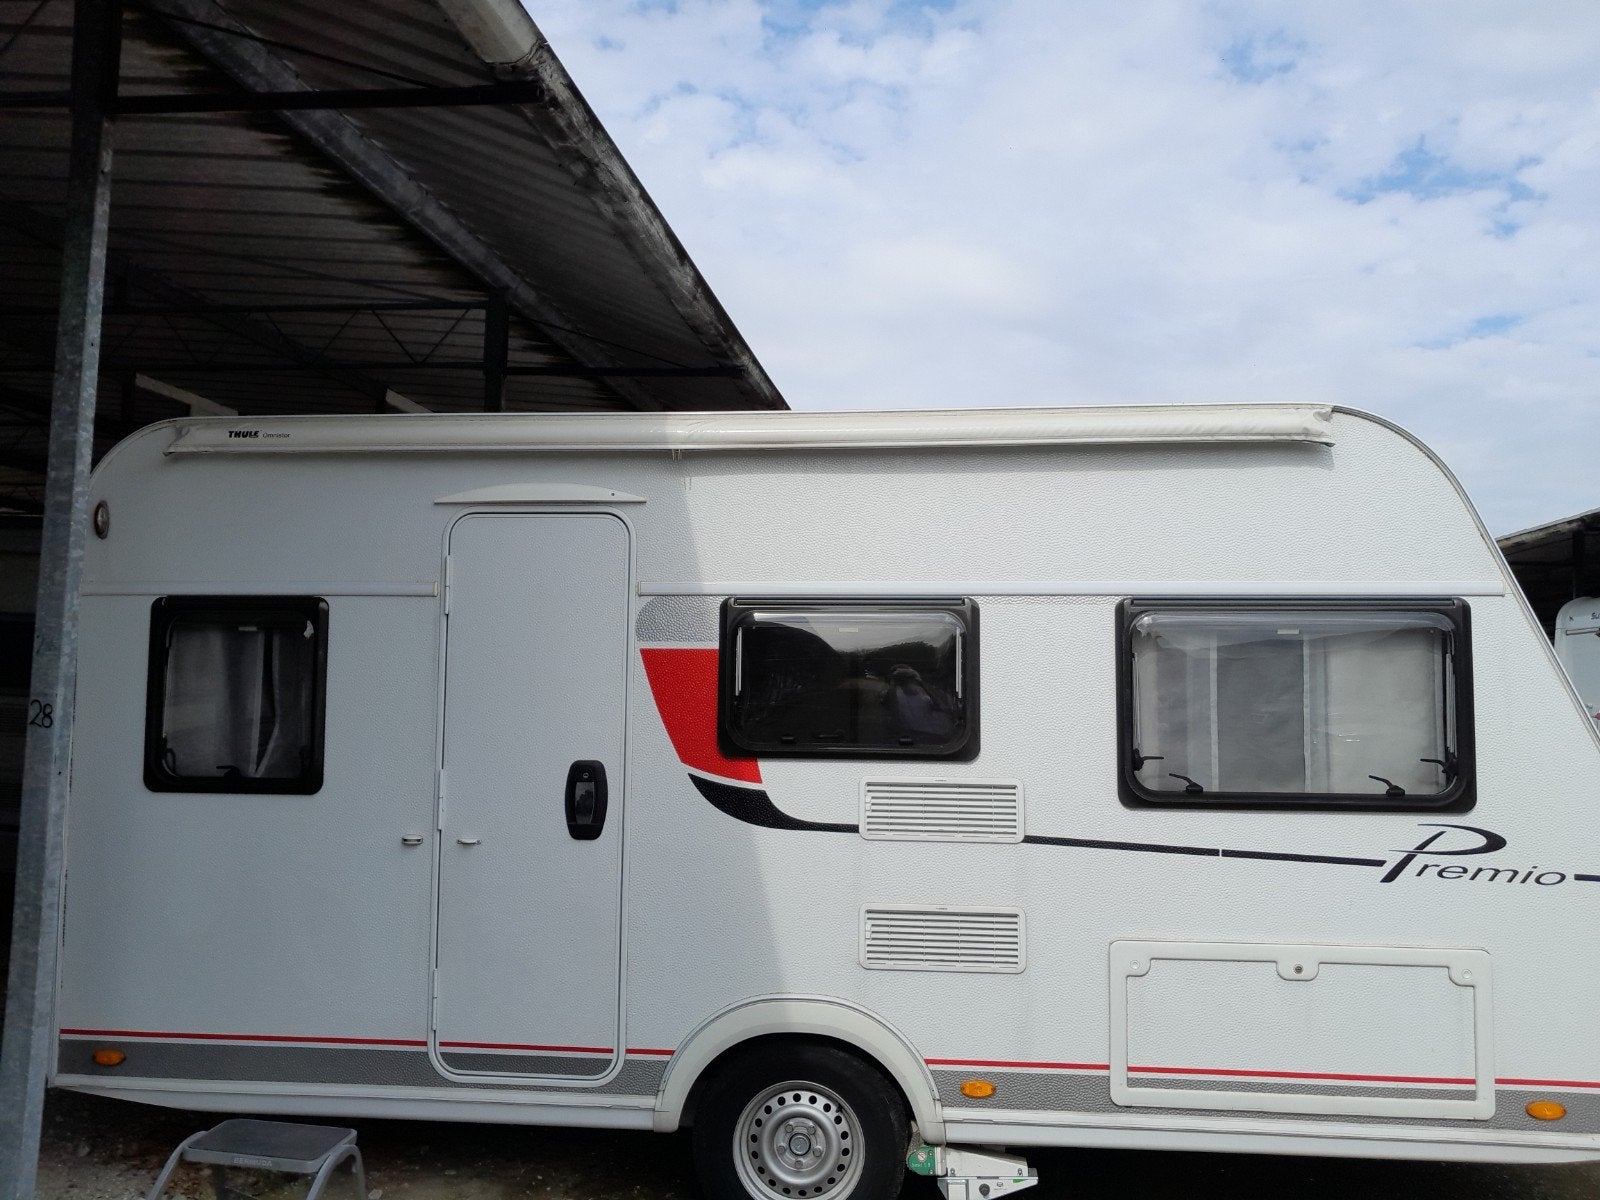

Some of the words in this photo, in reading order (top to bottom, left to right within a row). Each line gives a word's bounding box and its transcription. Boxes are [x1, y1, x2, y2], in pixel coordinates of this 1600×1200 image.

[228, 430, 260, 439] THULE
[29, 699, 53, 728] 28
[1380, 823, 1567, 886] Premio
[233, 1156, 273, 1168] BERMUDA
